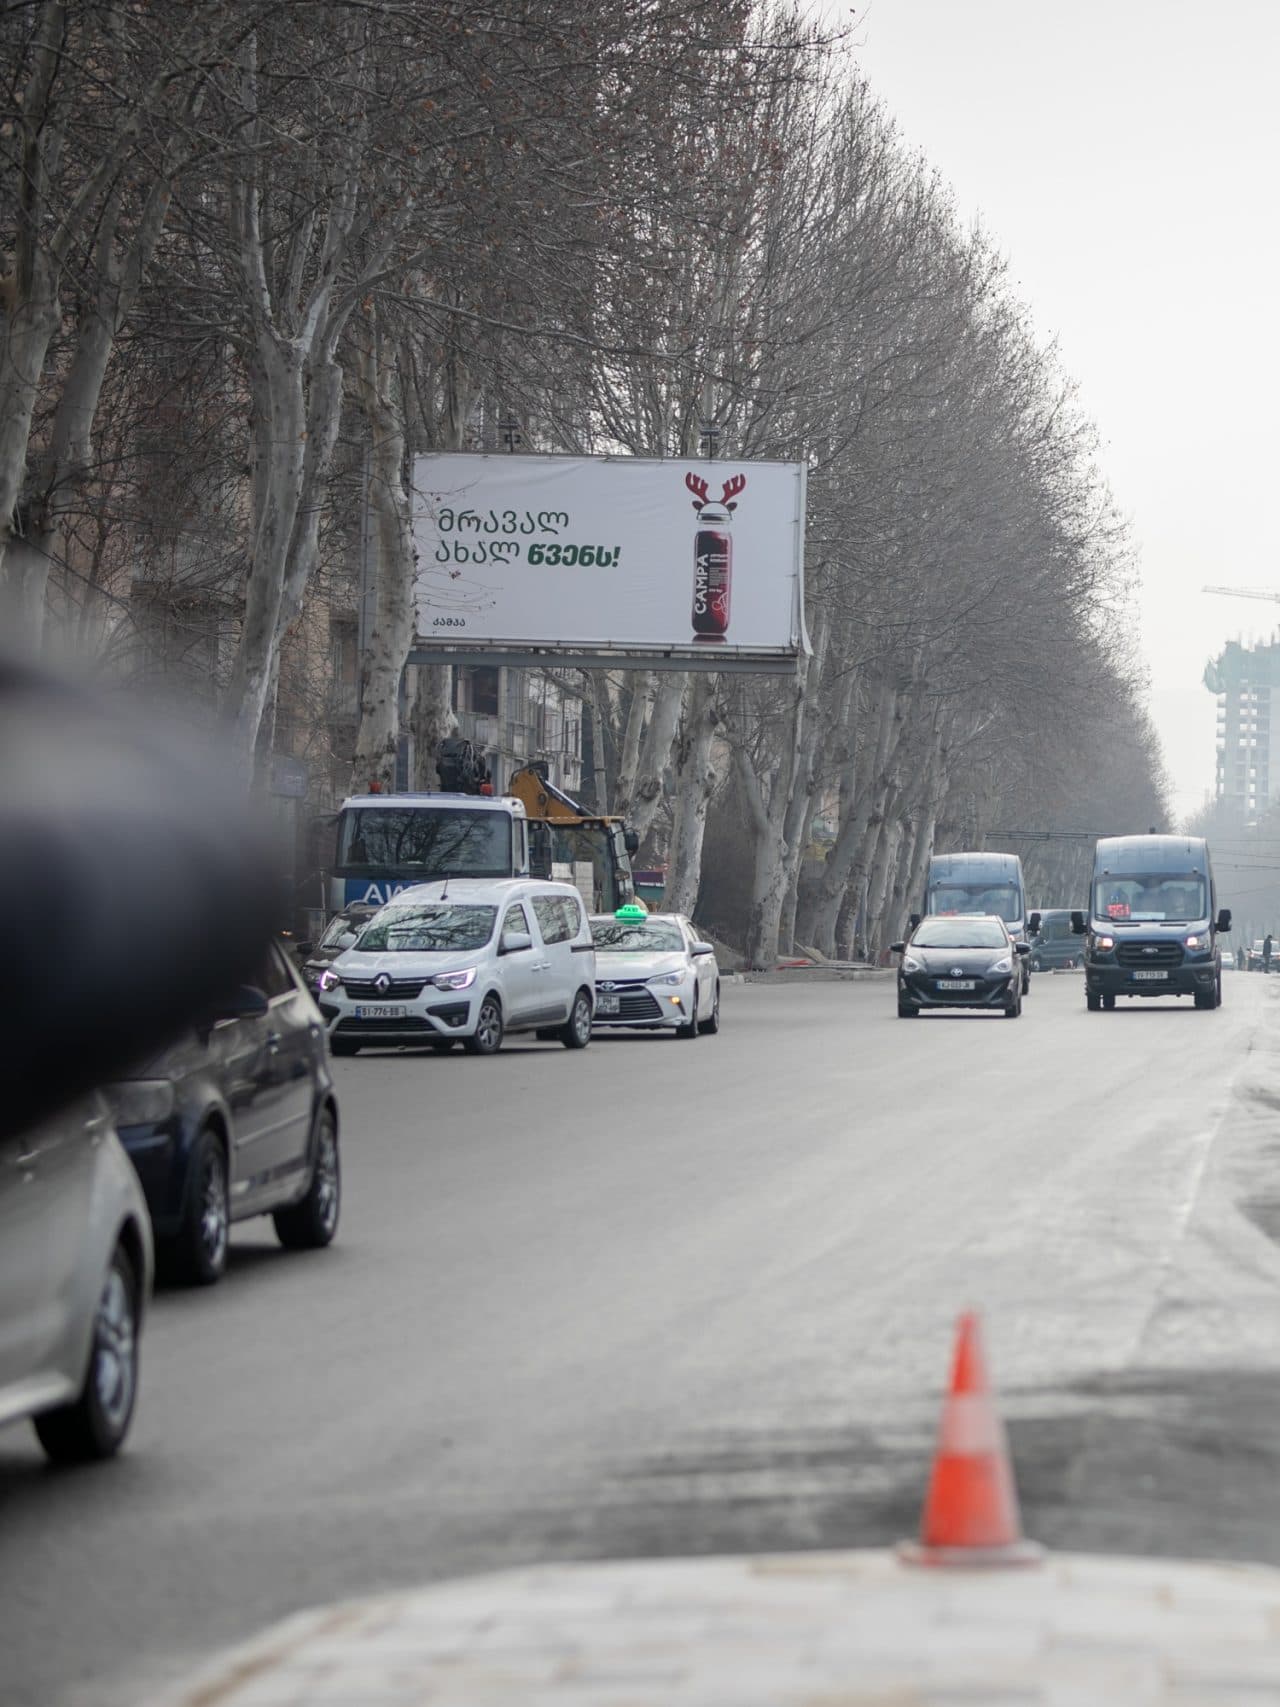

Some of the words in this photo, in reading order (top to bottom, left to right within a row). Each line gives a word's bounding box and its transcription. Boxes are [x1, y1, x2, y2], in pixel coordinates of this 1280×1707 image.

[438, 508, 569, 535] მრავალ
[435, 540, 520, 564] ახალ
[527, 543, 621, 567] წვენს!
[695, 553, 709, 614] CAMPA
